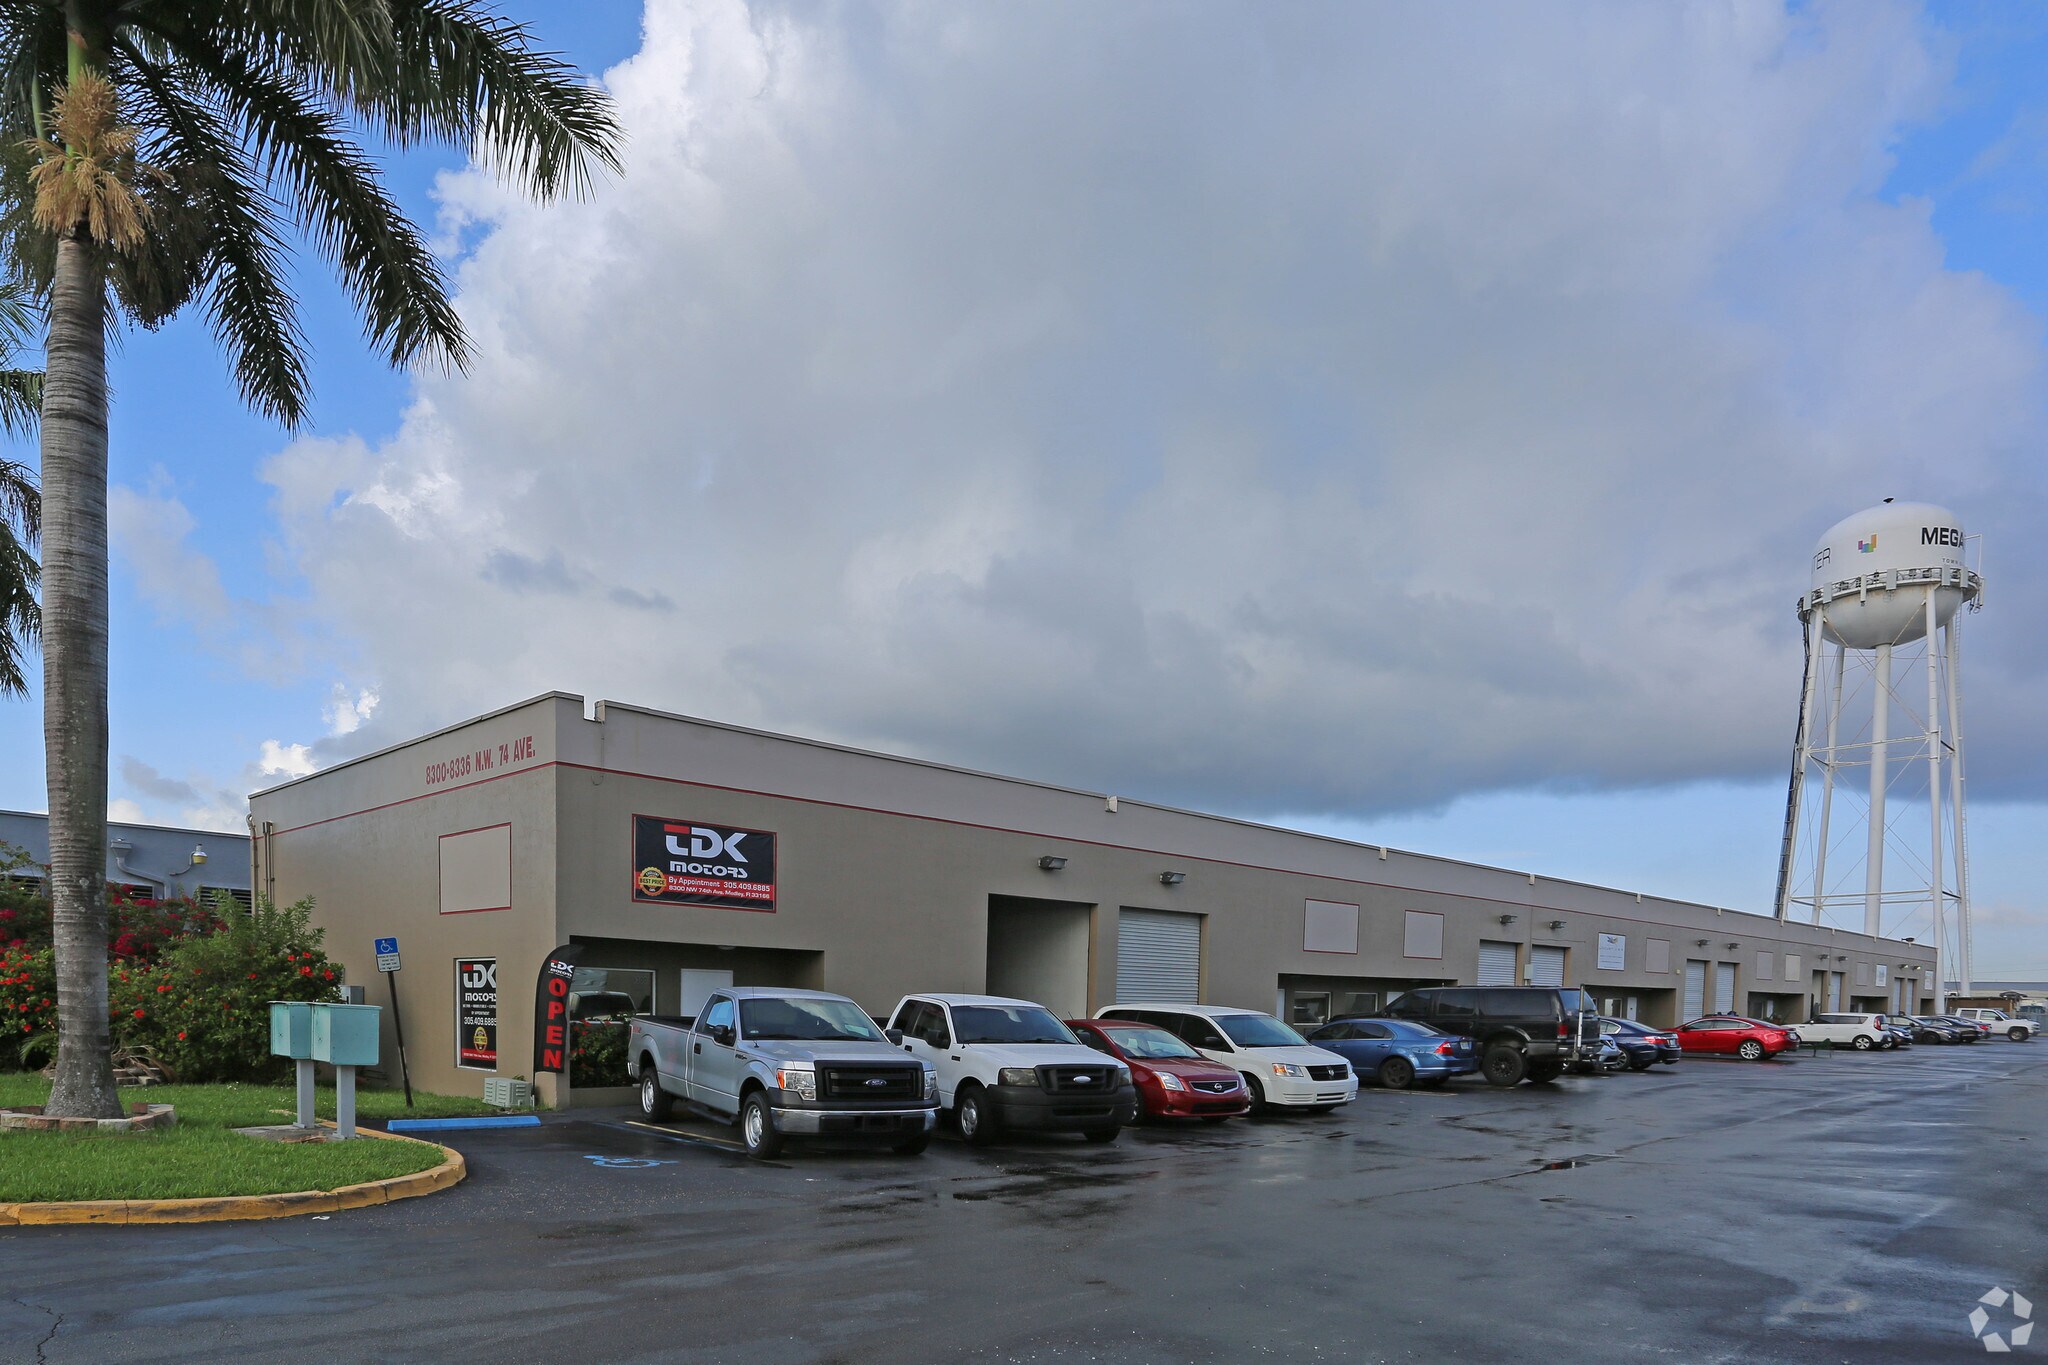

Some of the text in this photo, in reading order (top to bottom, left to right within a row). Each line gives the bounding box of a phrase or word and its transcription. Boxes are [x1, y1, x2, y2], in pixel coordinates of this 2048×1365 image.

[1921, 527, 1965, 551] MEGA
[426, 736, 536, 785] 8300-8336 N.W. 74 AVE.
[664, 824, 748, 863] LDK
[670, 860, 748, 879] MOTORS
[669, 876, 678, 885] By
[679, 877, 720, 888] Appointment
[463, 964, 496, 988] LDK
[550, 960, 574, 974] LDK
[543, 977, 568, 1069] OPEN
